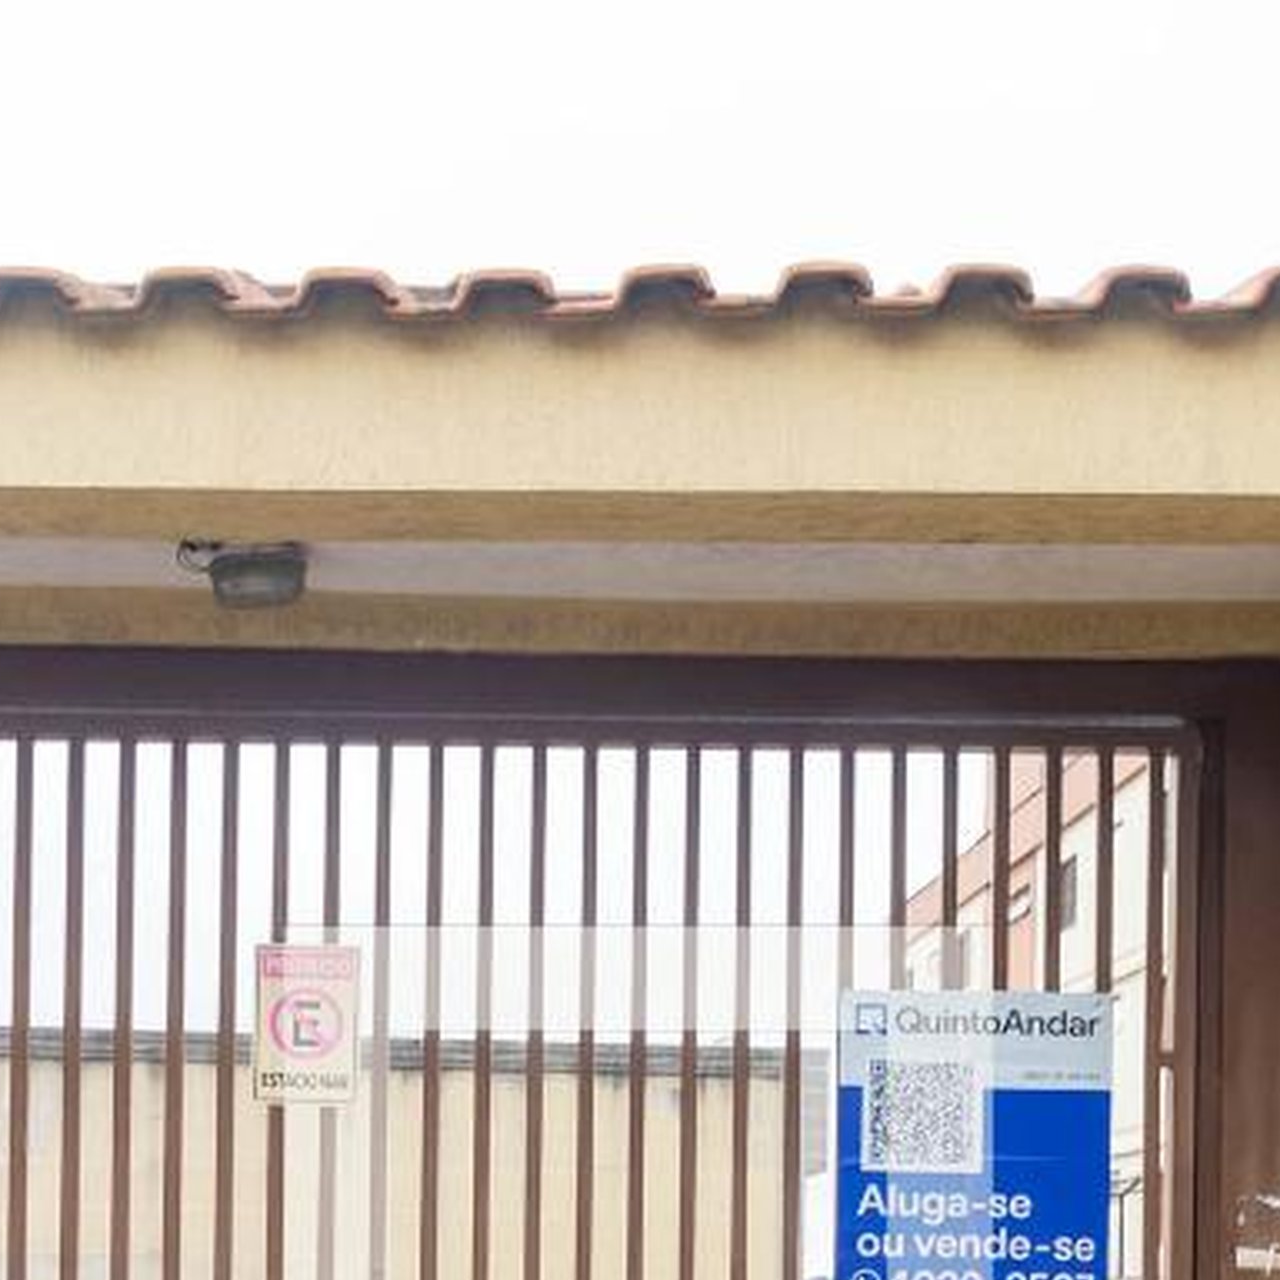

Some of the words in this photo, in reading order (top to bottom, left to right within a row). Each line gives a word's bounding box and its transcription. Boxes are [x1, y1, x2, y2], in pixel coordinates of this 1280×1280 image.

[895, 1005, 1102, 1039] QuintoAndar
[856, 1183, 1032, 1225] Aluga-se
[856, 1231, 906, 1259] ou
[914, 1228, 1096, 1261] vende-se
